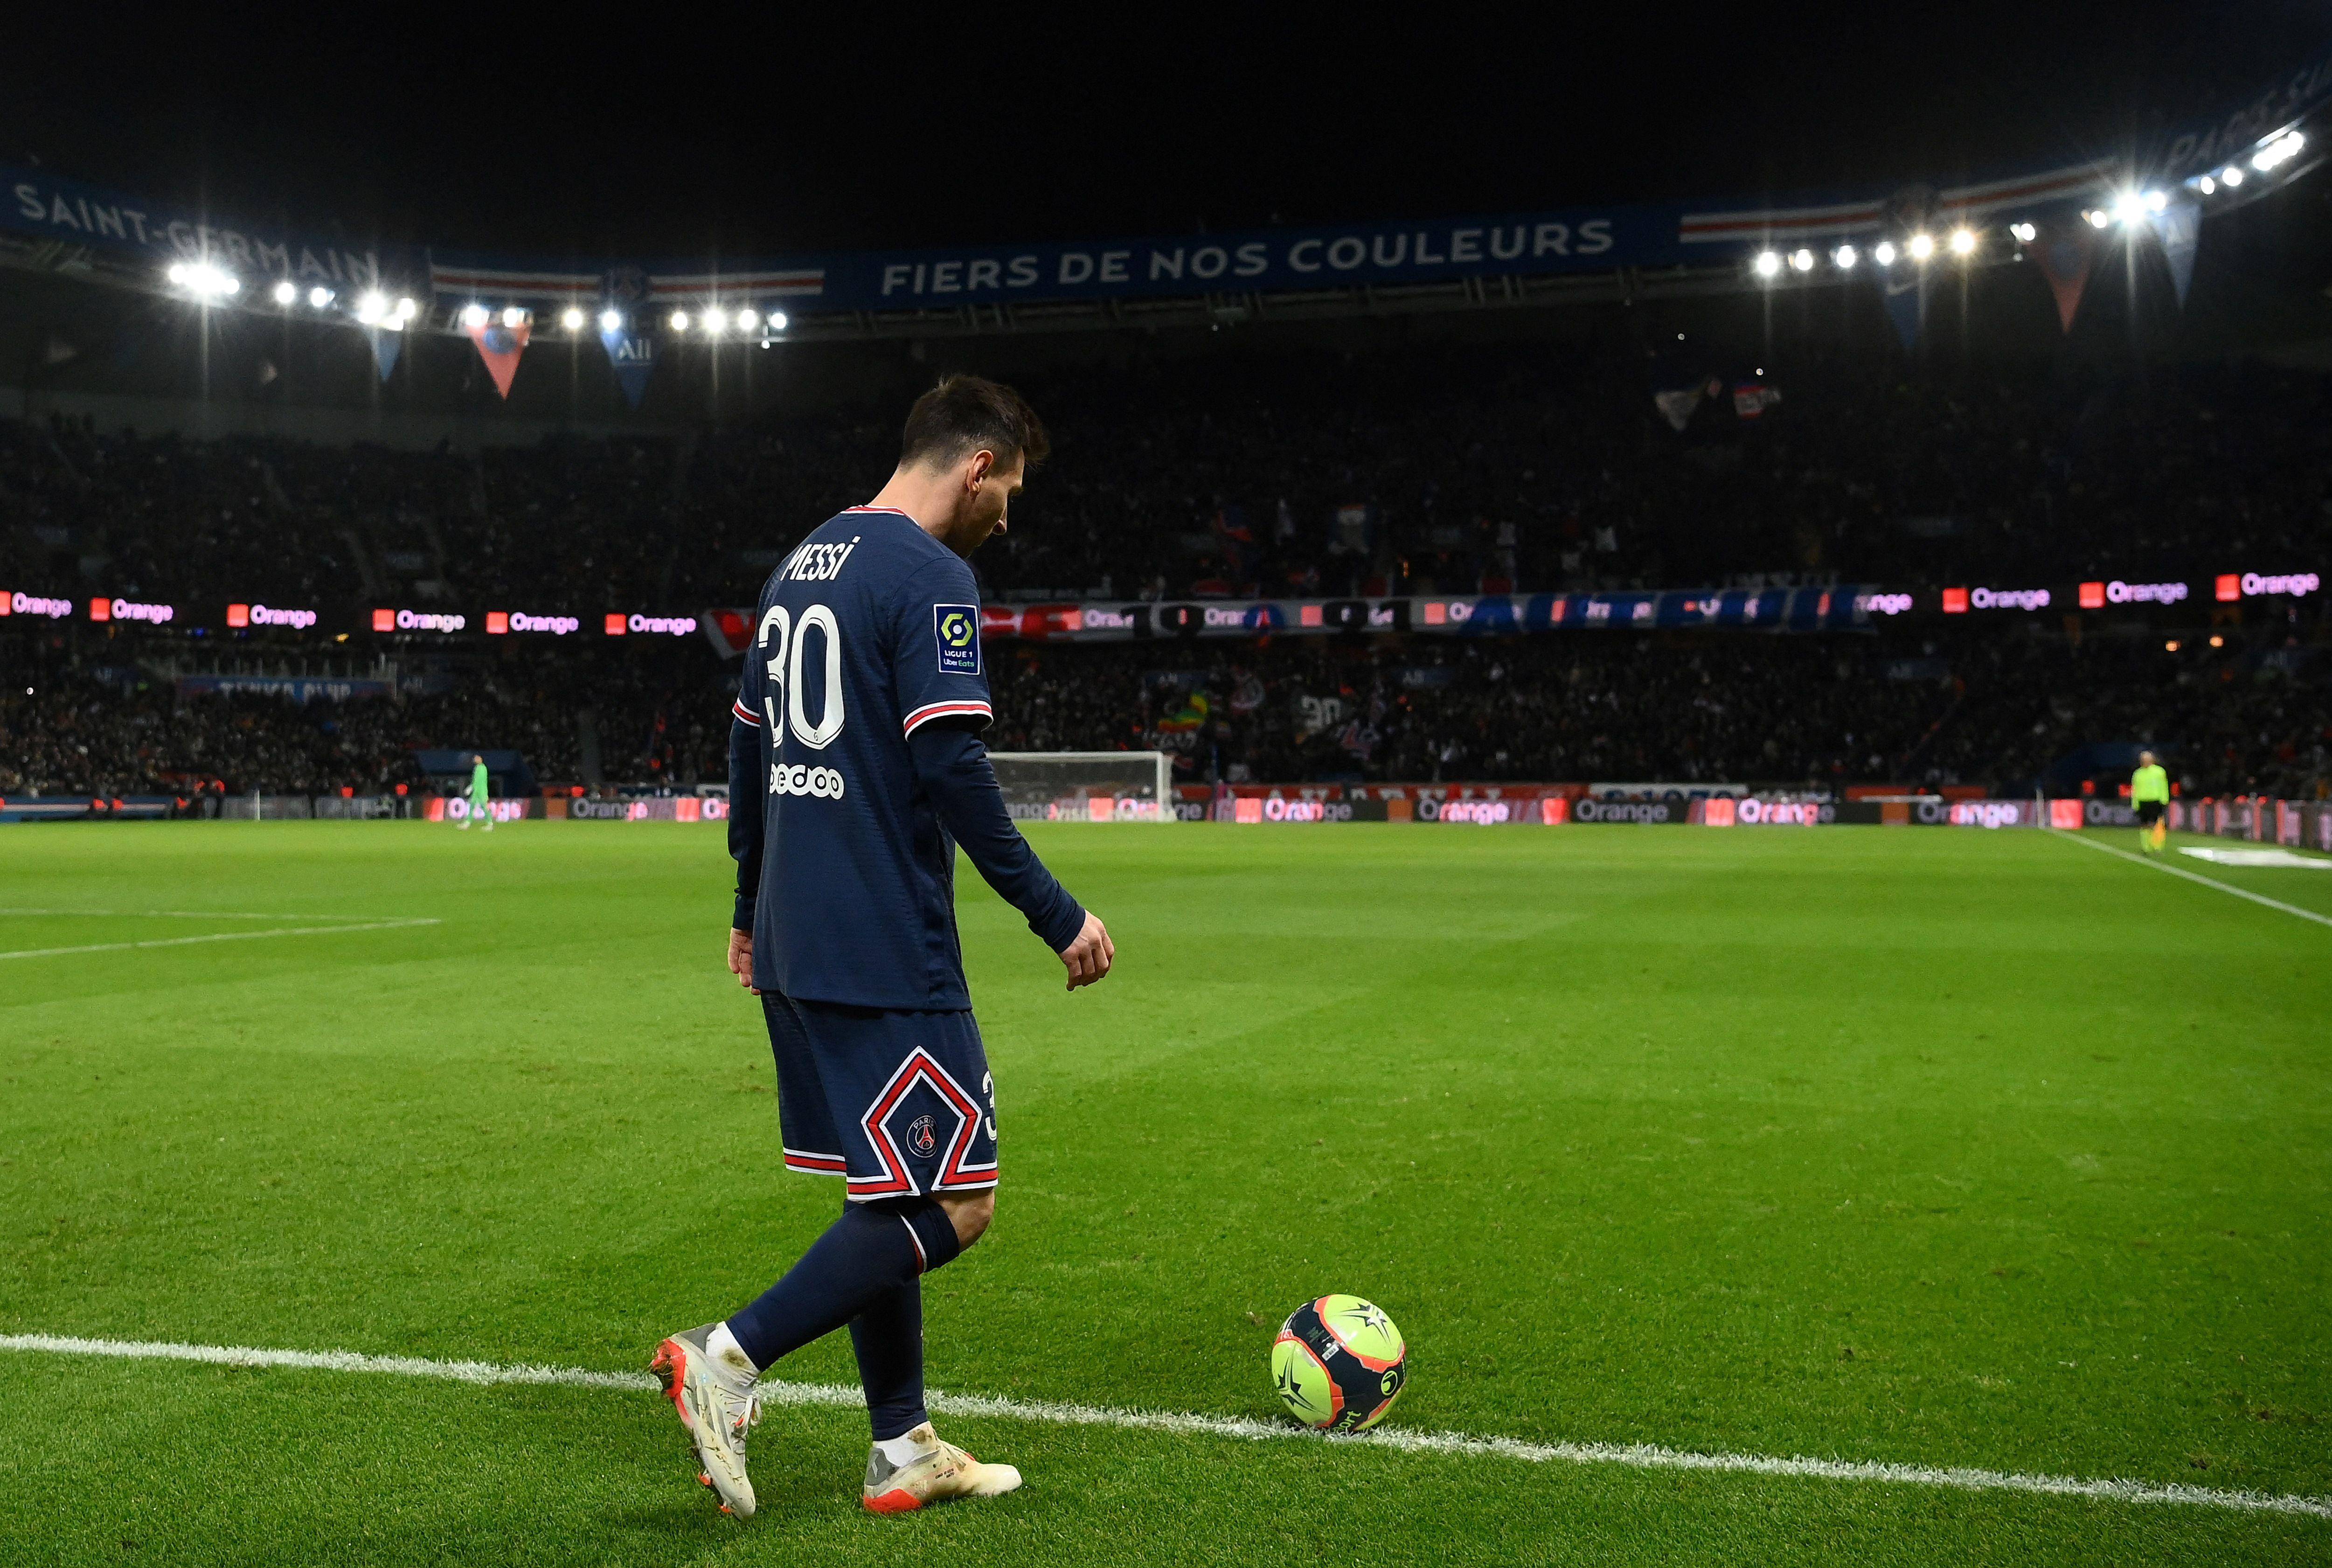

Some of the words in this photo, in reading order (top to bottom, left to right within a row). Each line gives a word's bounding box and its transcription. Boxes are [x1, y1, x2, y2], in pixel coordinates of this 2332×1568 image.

[14, 184, 380, 281] SAINT-GERMAIN
[882, 255, 1038, 296] FIERS
[1058, 250, 1131, 286] DE
[1149, 242, 1269, 281] NOS
[1288, 219, 1614, 272] COULEURS
[2106, 580, 2188, 605] Orange
[2241, 572, 2319, 597] Orange
[12, 591, 72, 619] Orange
[111, 598, 174, 624] Orange
[1971, 587, 2051, 611] Orange
[250, 604, 317, 629] Orange
[396, 609, 465, 633] Orange
[509, 611, 579, 636] Orange
[629, 613, 696, 636] Orange
[758, 604, 845, 750] 30
[573, 797, 648, 821] Orange
[1264, 798, 1351, 822] Orange
[1418, 798, 1509, 825] Orange
[1576, 799, 1668, 824] Orange
[1738, 798, 1835, 826] Orange
[1917, 801, 2019, 829] Orange
[913, 1117, 934, 1130] PARIS
